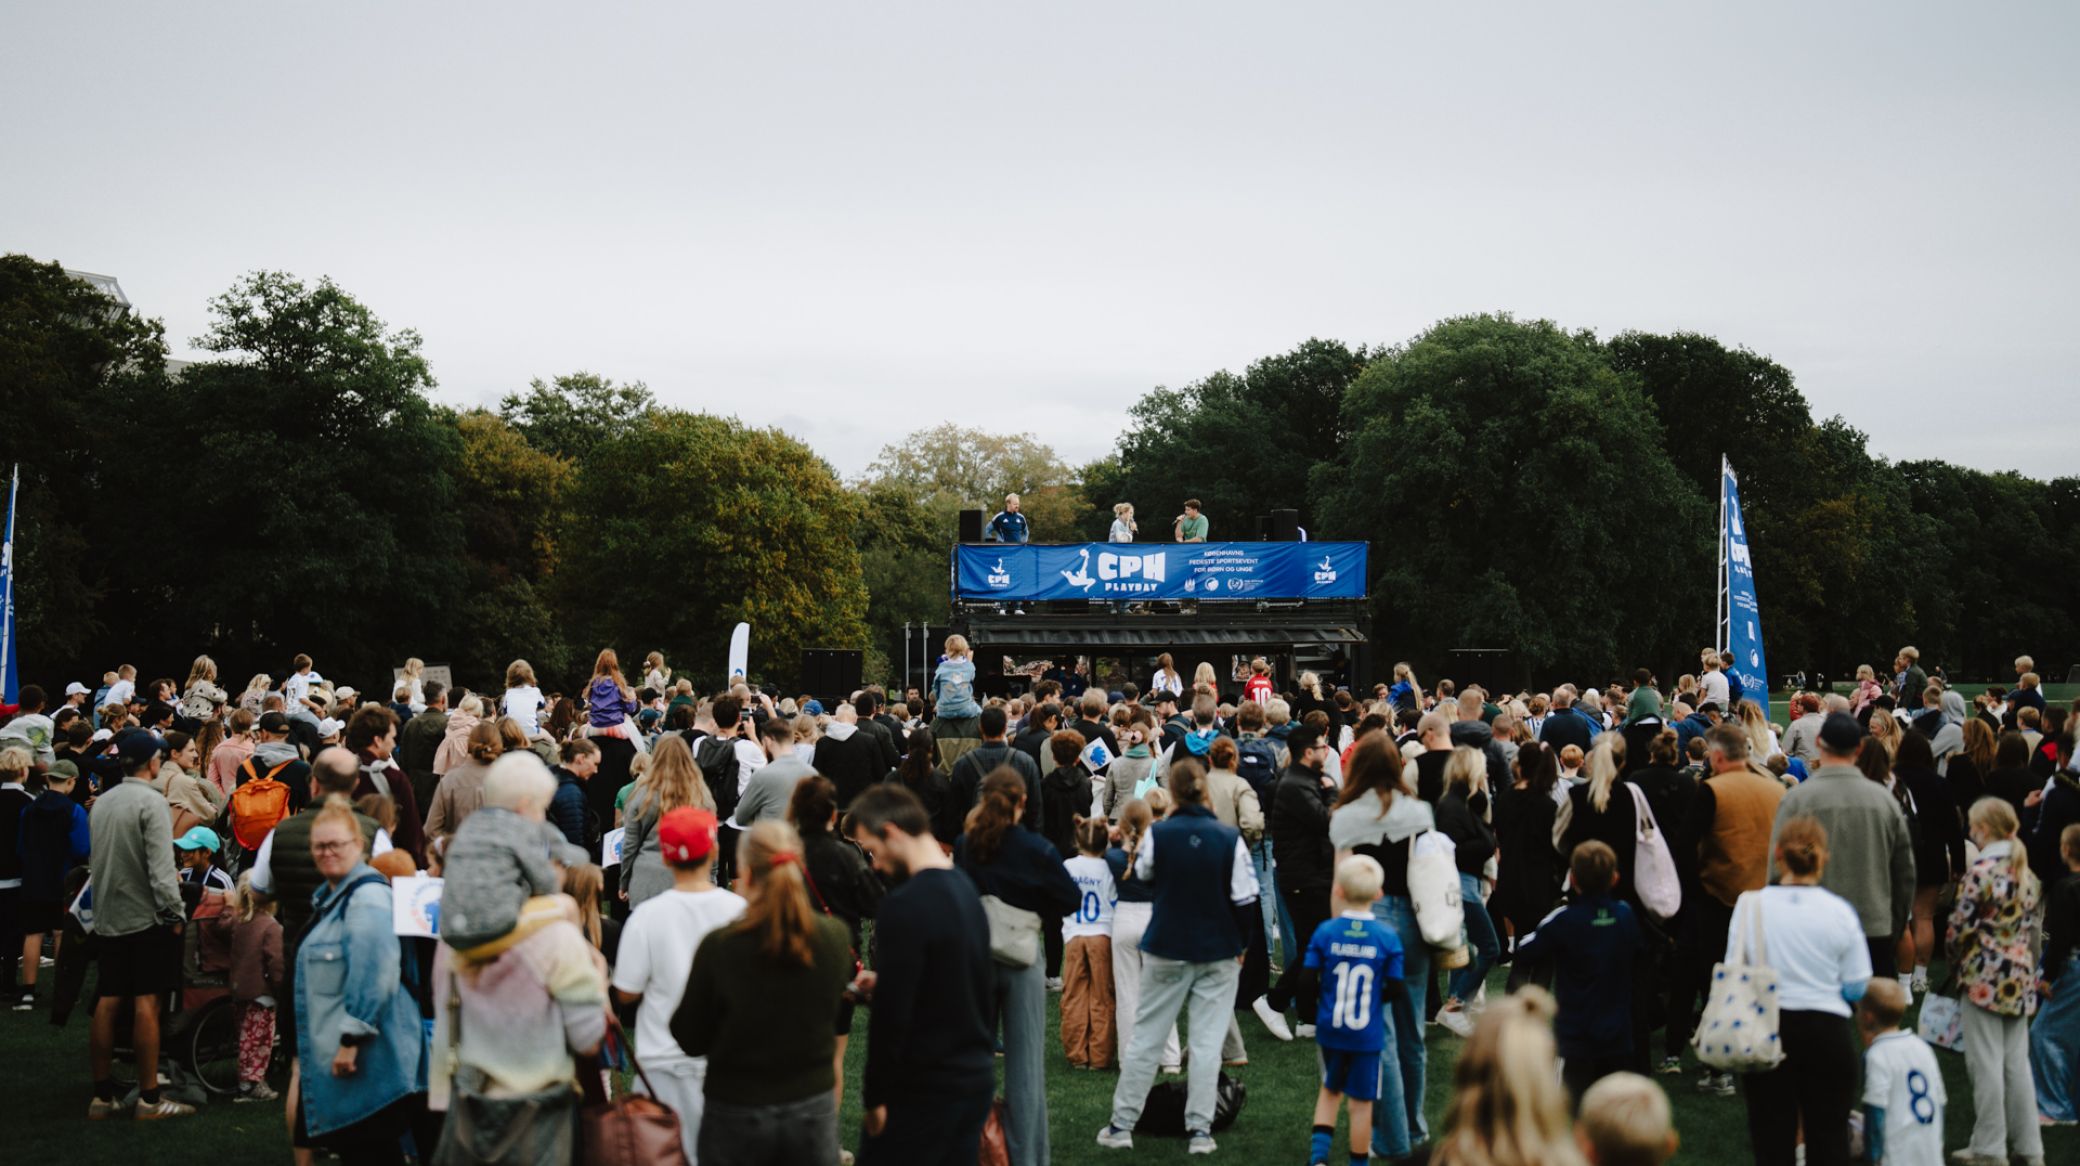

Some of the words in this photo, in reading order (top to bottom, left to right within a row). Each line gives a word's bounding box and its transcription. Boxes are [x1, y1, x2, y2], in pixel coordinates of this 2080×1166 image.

[1098, 552, 1166, 583] CPH
[1314, 571, 1337, 581] CPH
[988, 574, 1010, 584] CPH
[1104, 582, 1158, 592] PLAYDAY
[1252, 687, 1271, 706] 10
[1332, 961, 1375, 1031] 10
[1907, 1069, 1935, 1124] 8
